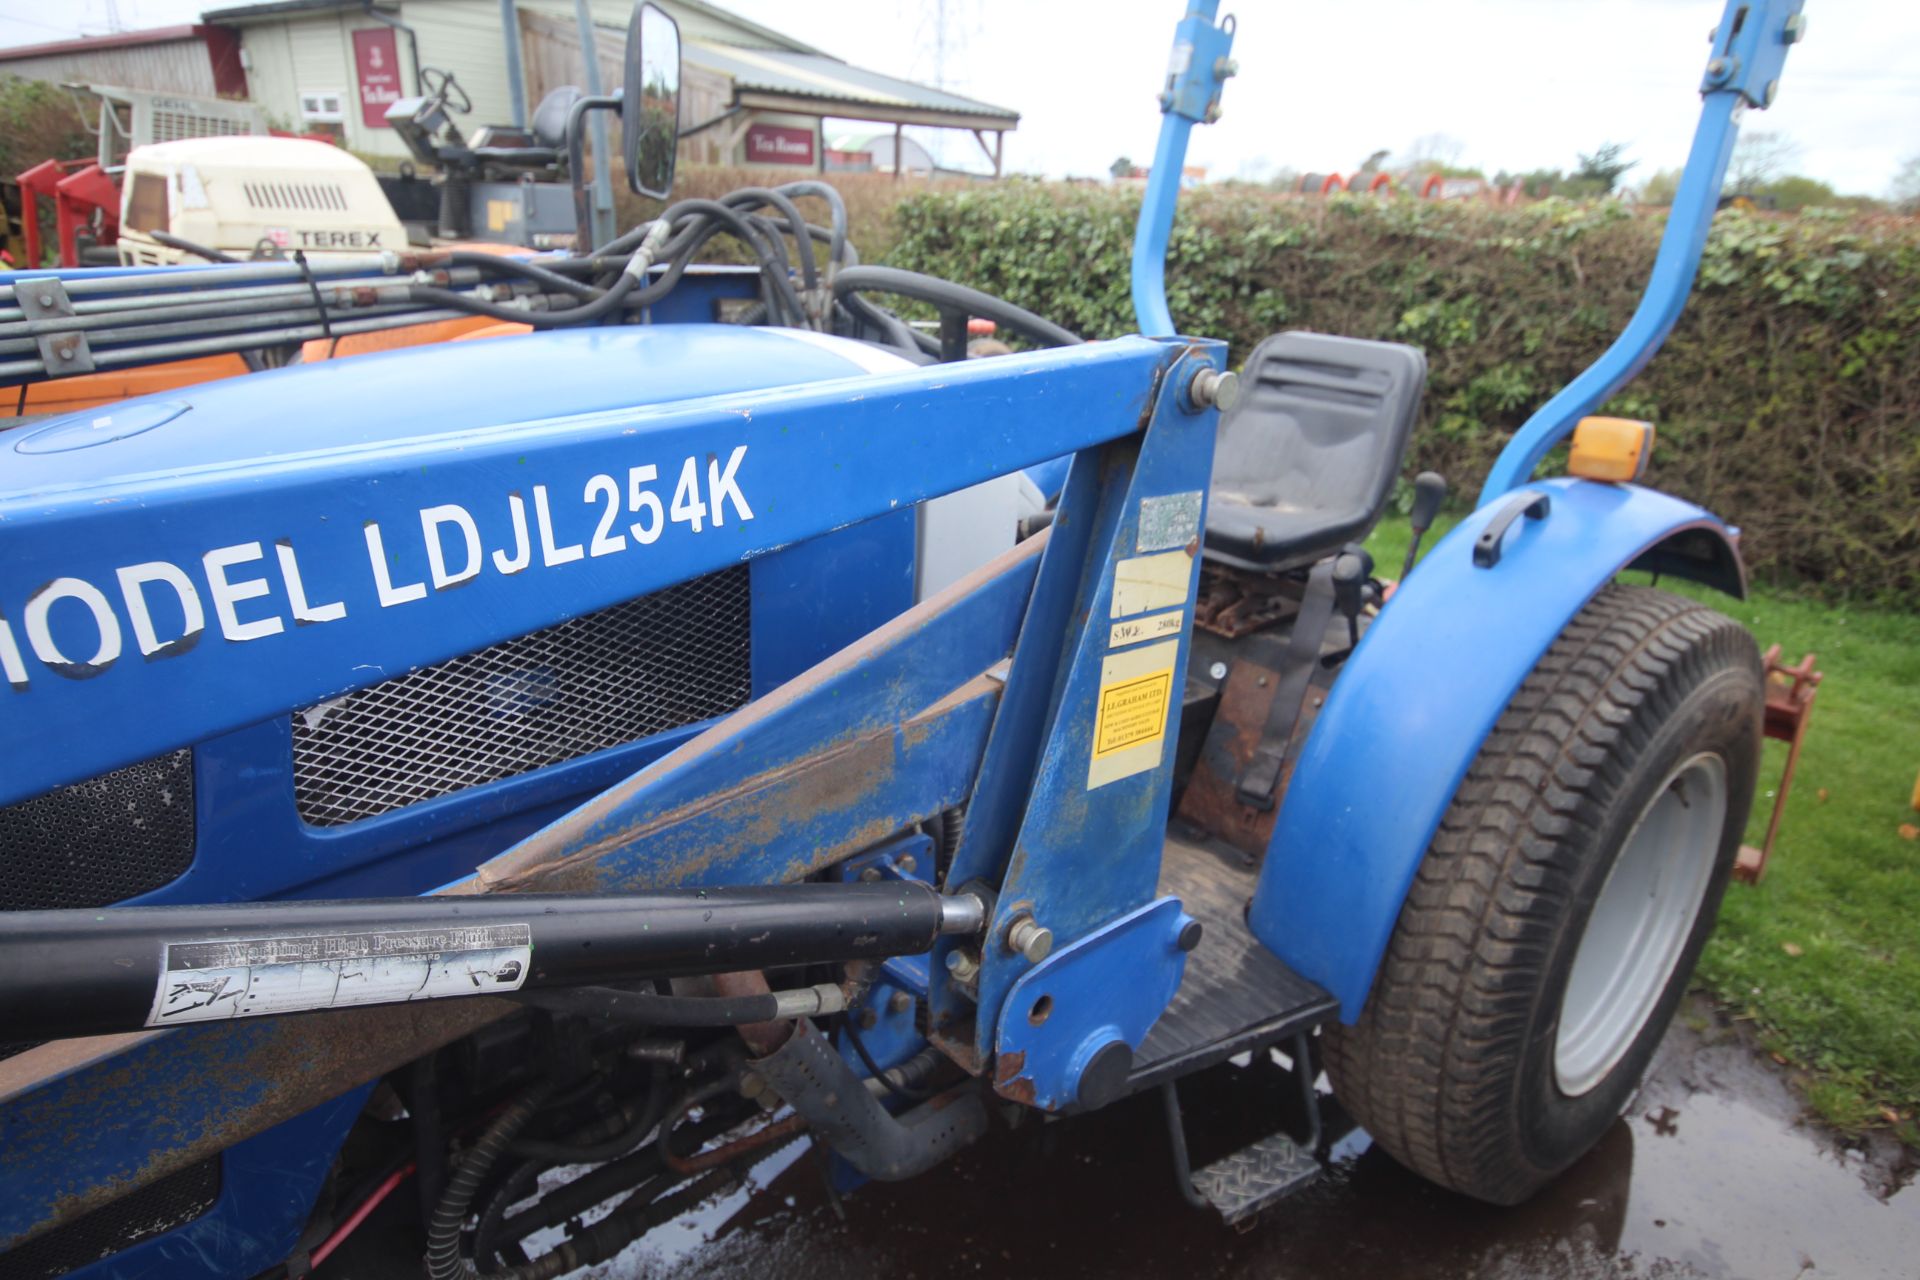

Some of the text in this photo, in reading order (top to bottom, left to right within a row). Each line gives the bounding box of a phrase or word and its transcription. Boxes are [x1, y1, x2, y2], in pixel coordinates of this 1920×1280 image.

[752, 134, 808, 154] Tea Room
[297, 231, 382, 247] TEREX
[364, 445, 754, 608] LDJL254K
[225, 929, 491, 960] Warning! High Pressure Fluid
